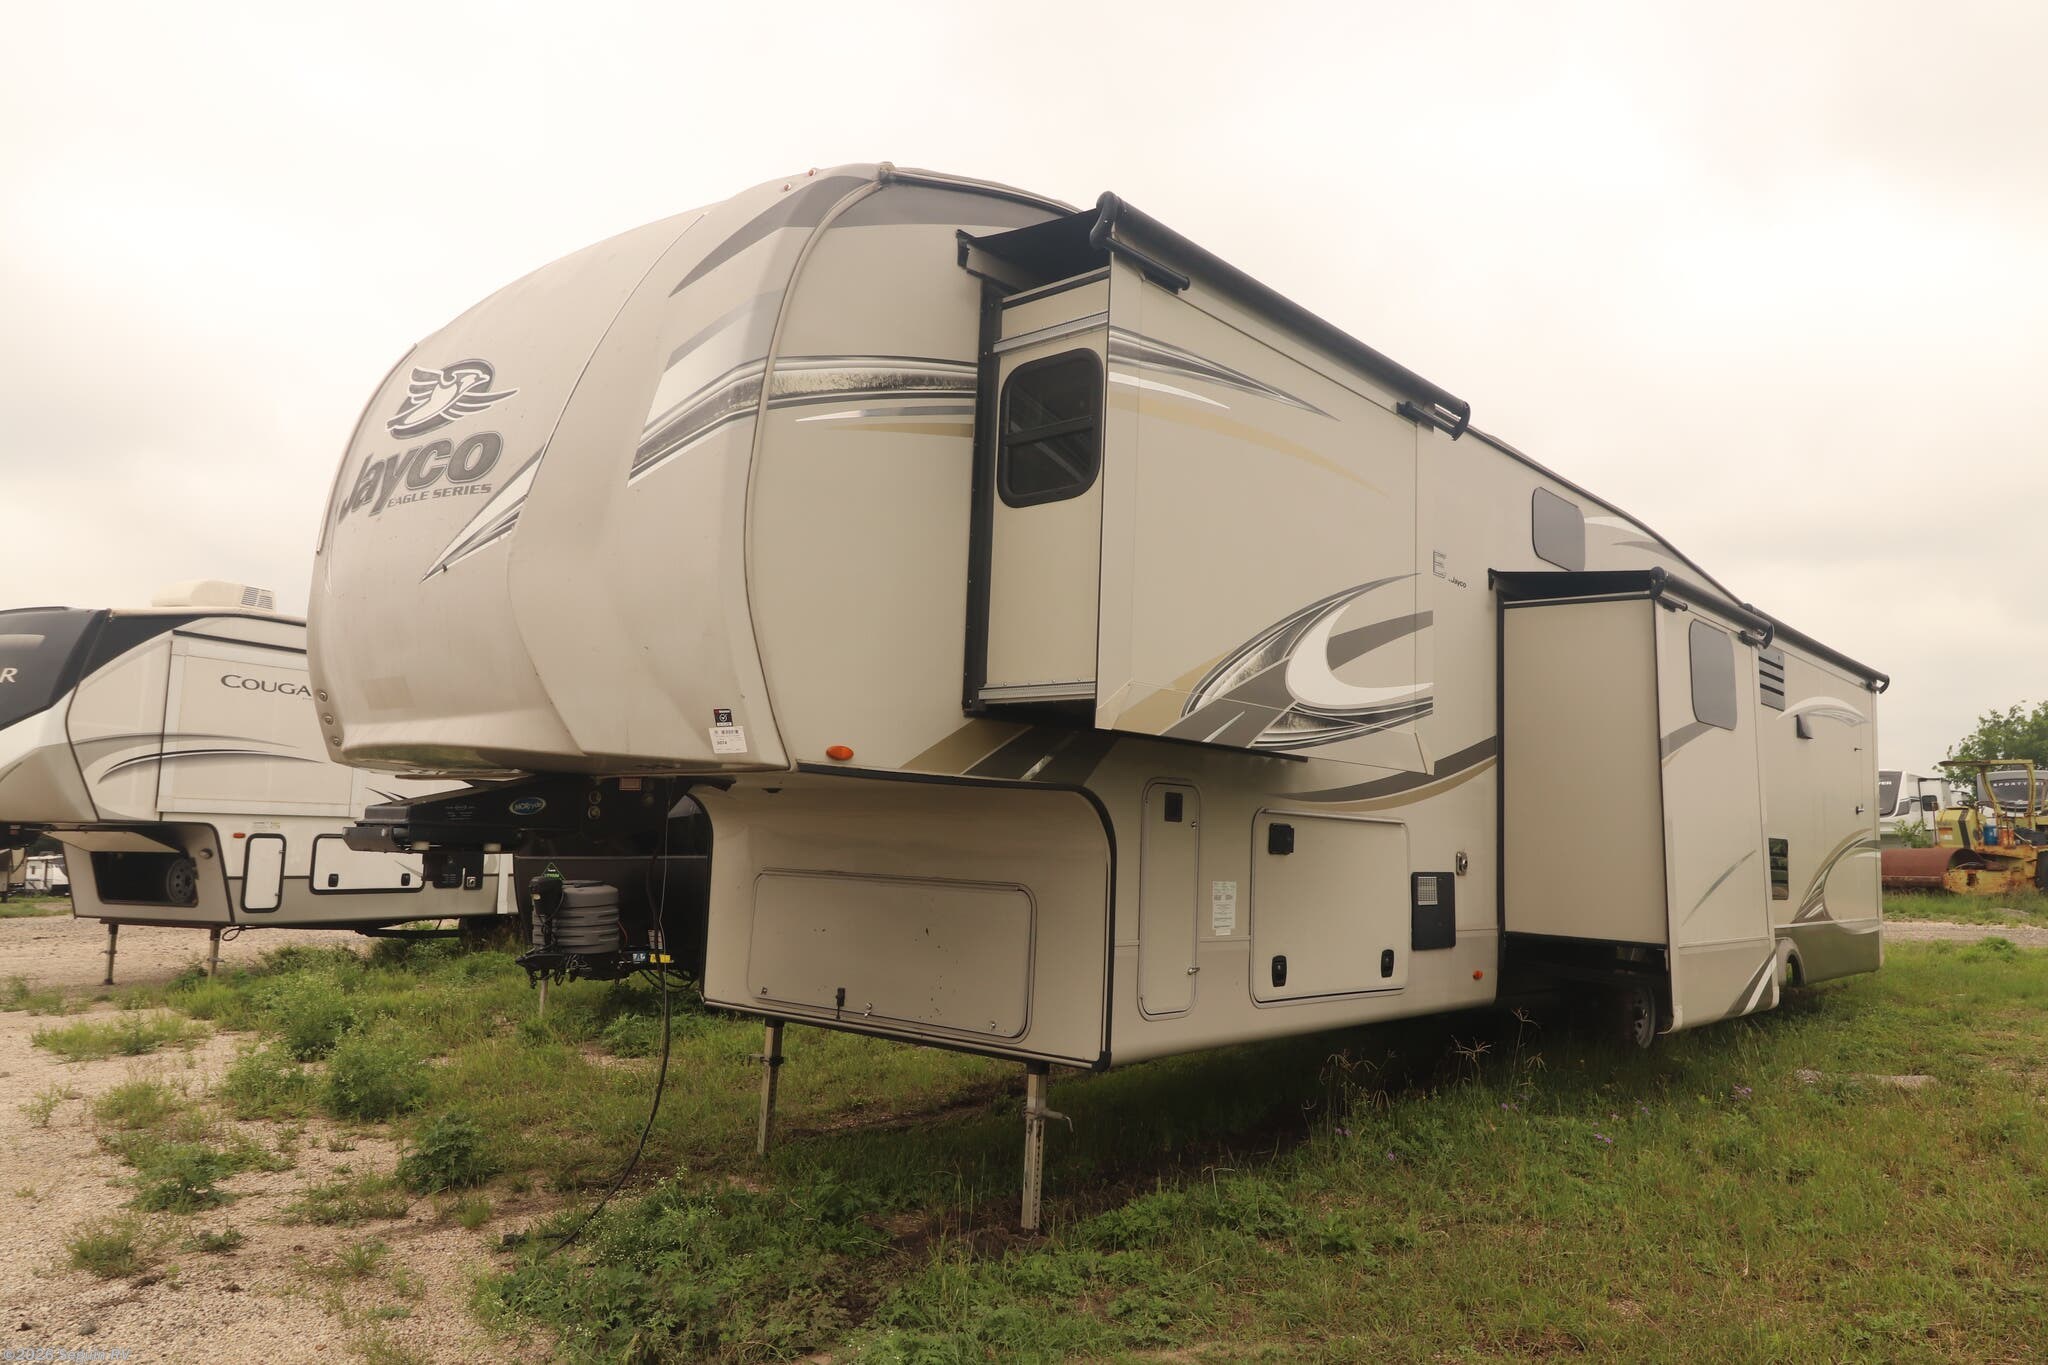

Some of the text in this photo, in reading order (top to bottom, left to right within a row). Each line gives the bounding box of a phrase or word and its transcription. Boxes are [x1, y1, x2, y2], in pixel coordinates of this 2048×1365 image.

[338, 431, 503, 524] Jayco
[387, 483, 493, 508] EAGLE SERIES
[0, 667, 18, 684] R
[220, 674, 312, 697] COUGA
